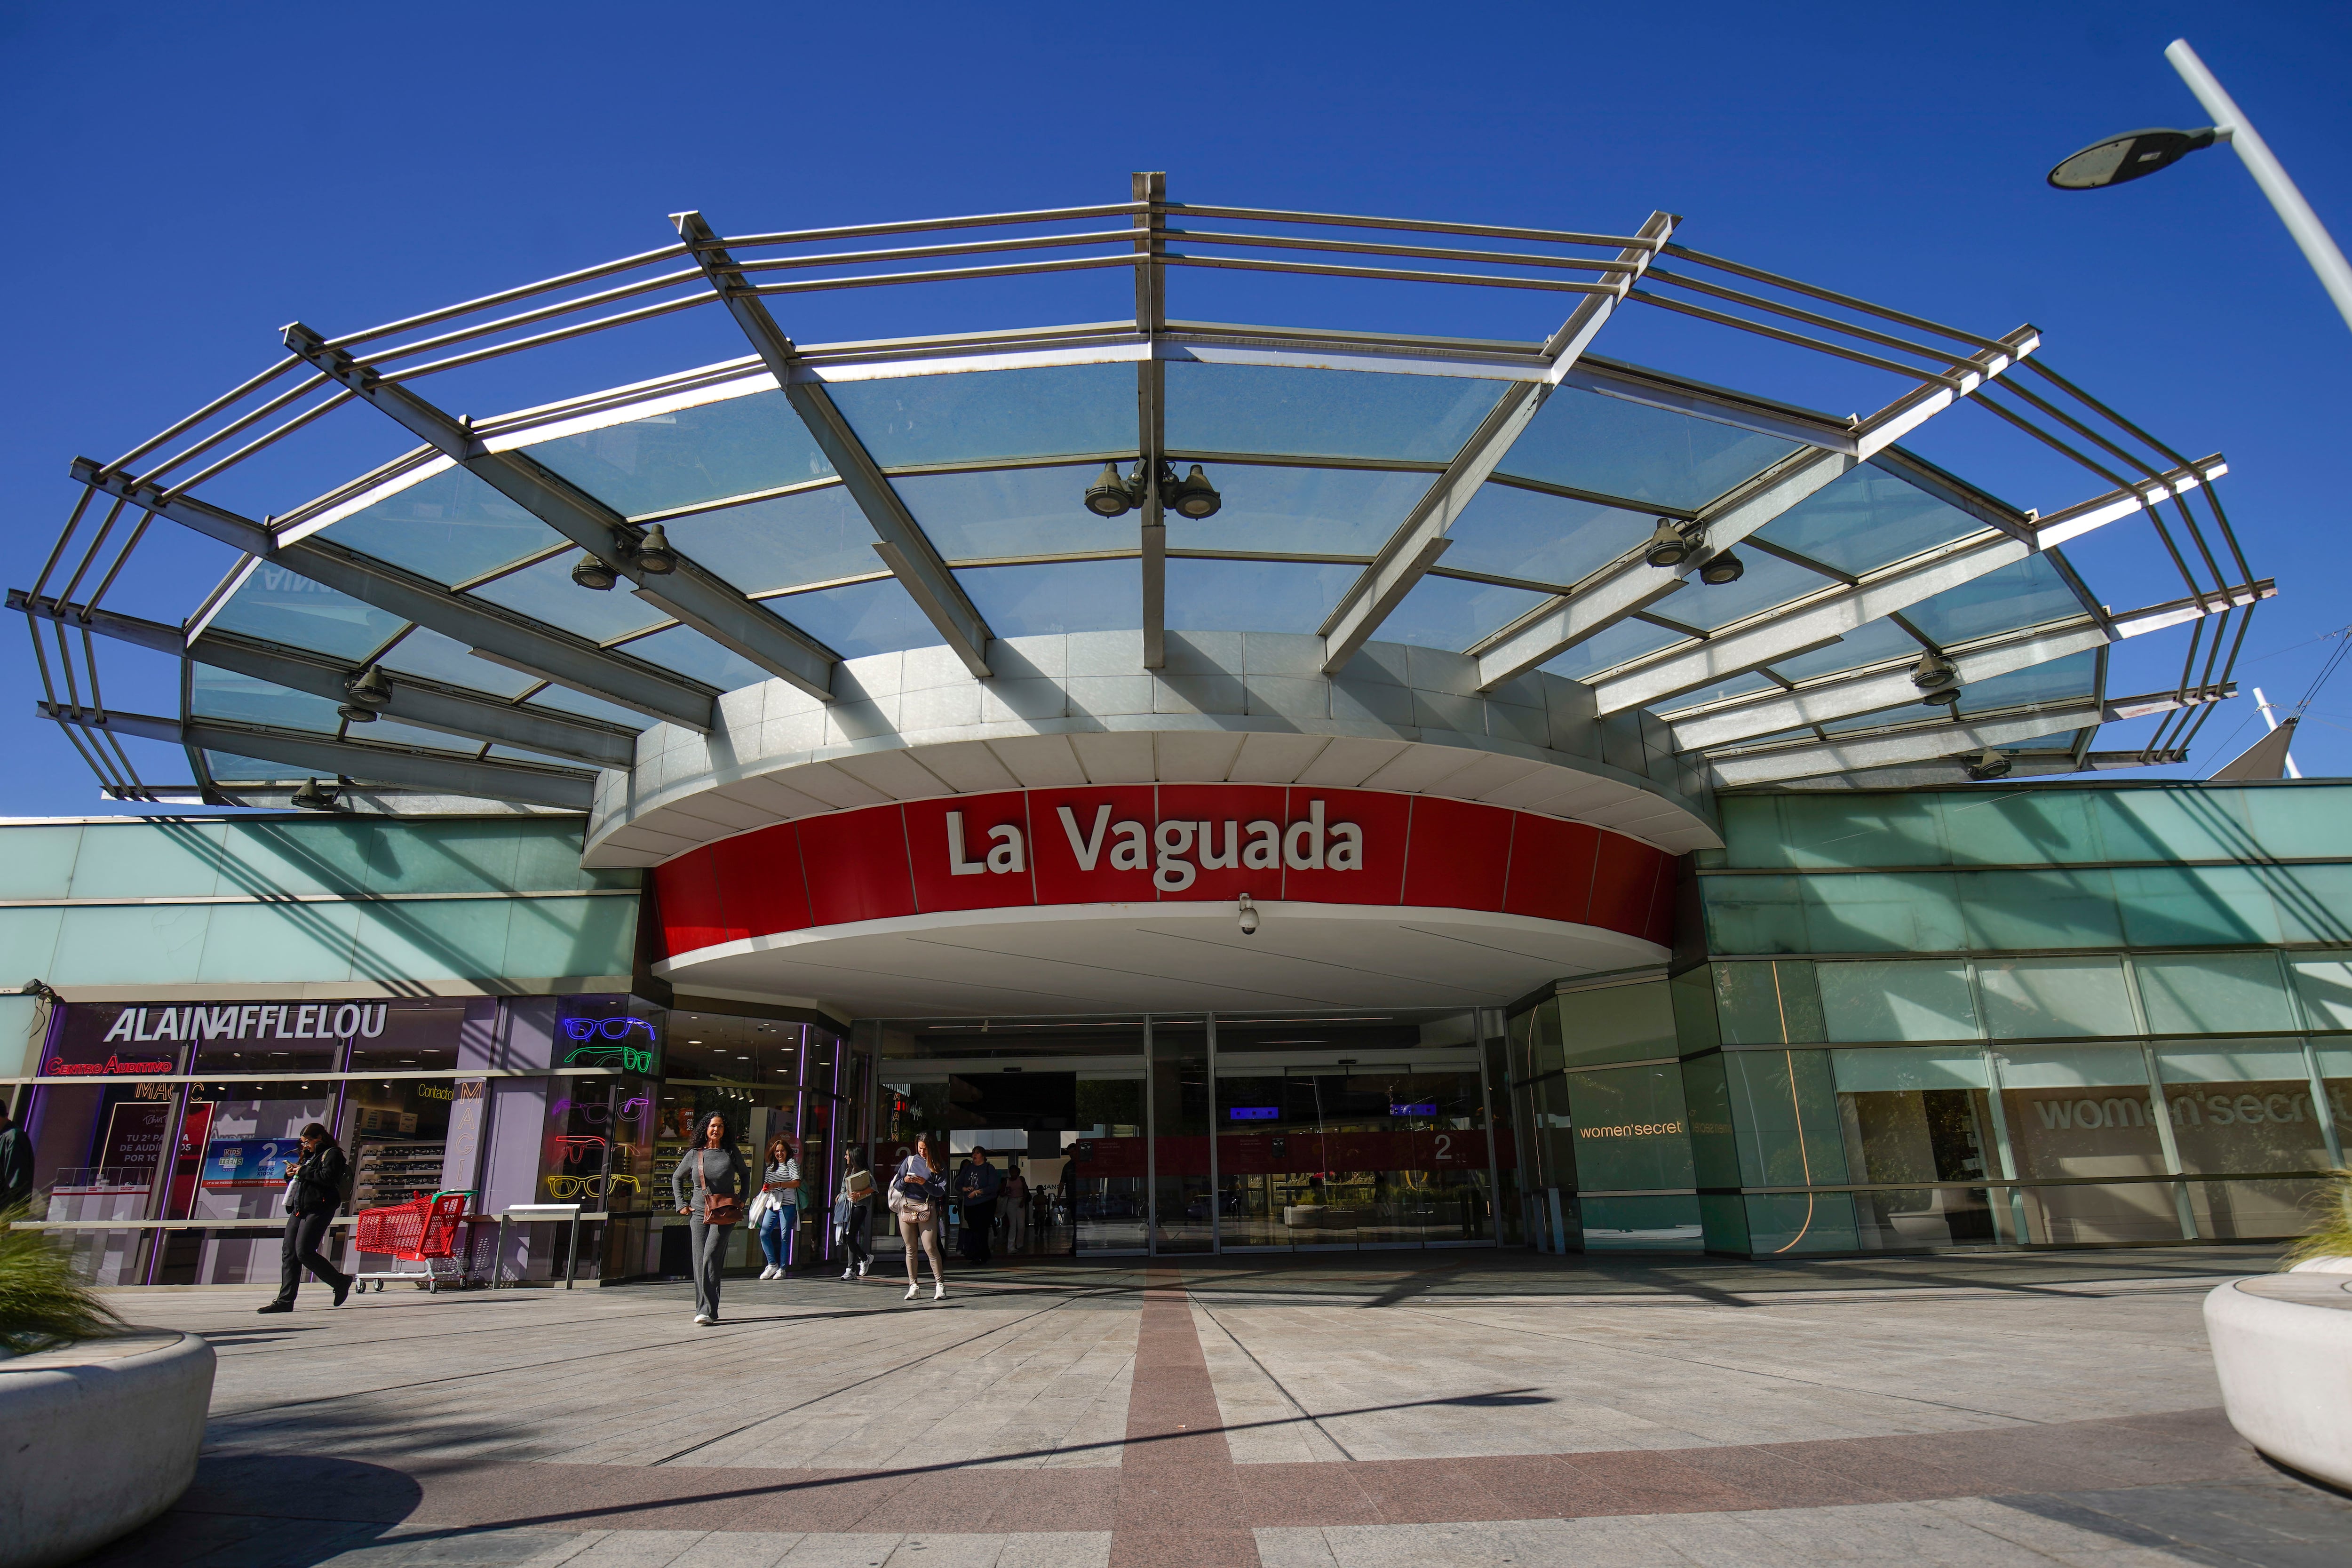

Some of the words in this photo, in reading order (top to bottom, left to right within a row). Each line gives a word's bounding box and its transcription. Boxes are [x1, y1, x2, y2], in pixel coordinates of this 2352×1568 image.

[946, 811, 1026, 876] La
[1057, 800, 1363, 892] Vaguada
[46, 1057, 103, 1075] CENTRO
[102, 1055, 173, 1074] AUDITIVO
[418, 1083, 454, 1101] Contacto
[453, 1082, 483, 1190] MAGI
[1580, 1121, 1683, 1138] women'secret
[258, 1142, 278, 1166] 2
[1435, 1134, 1452, 1160] 2
